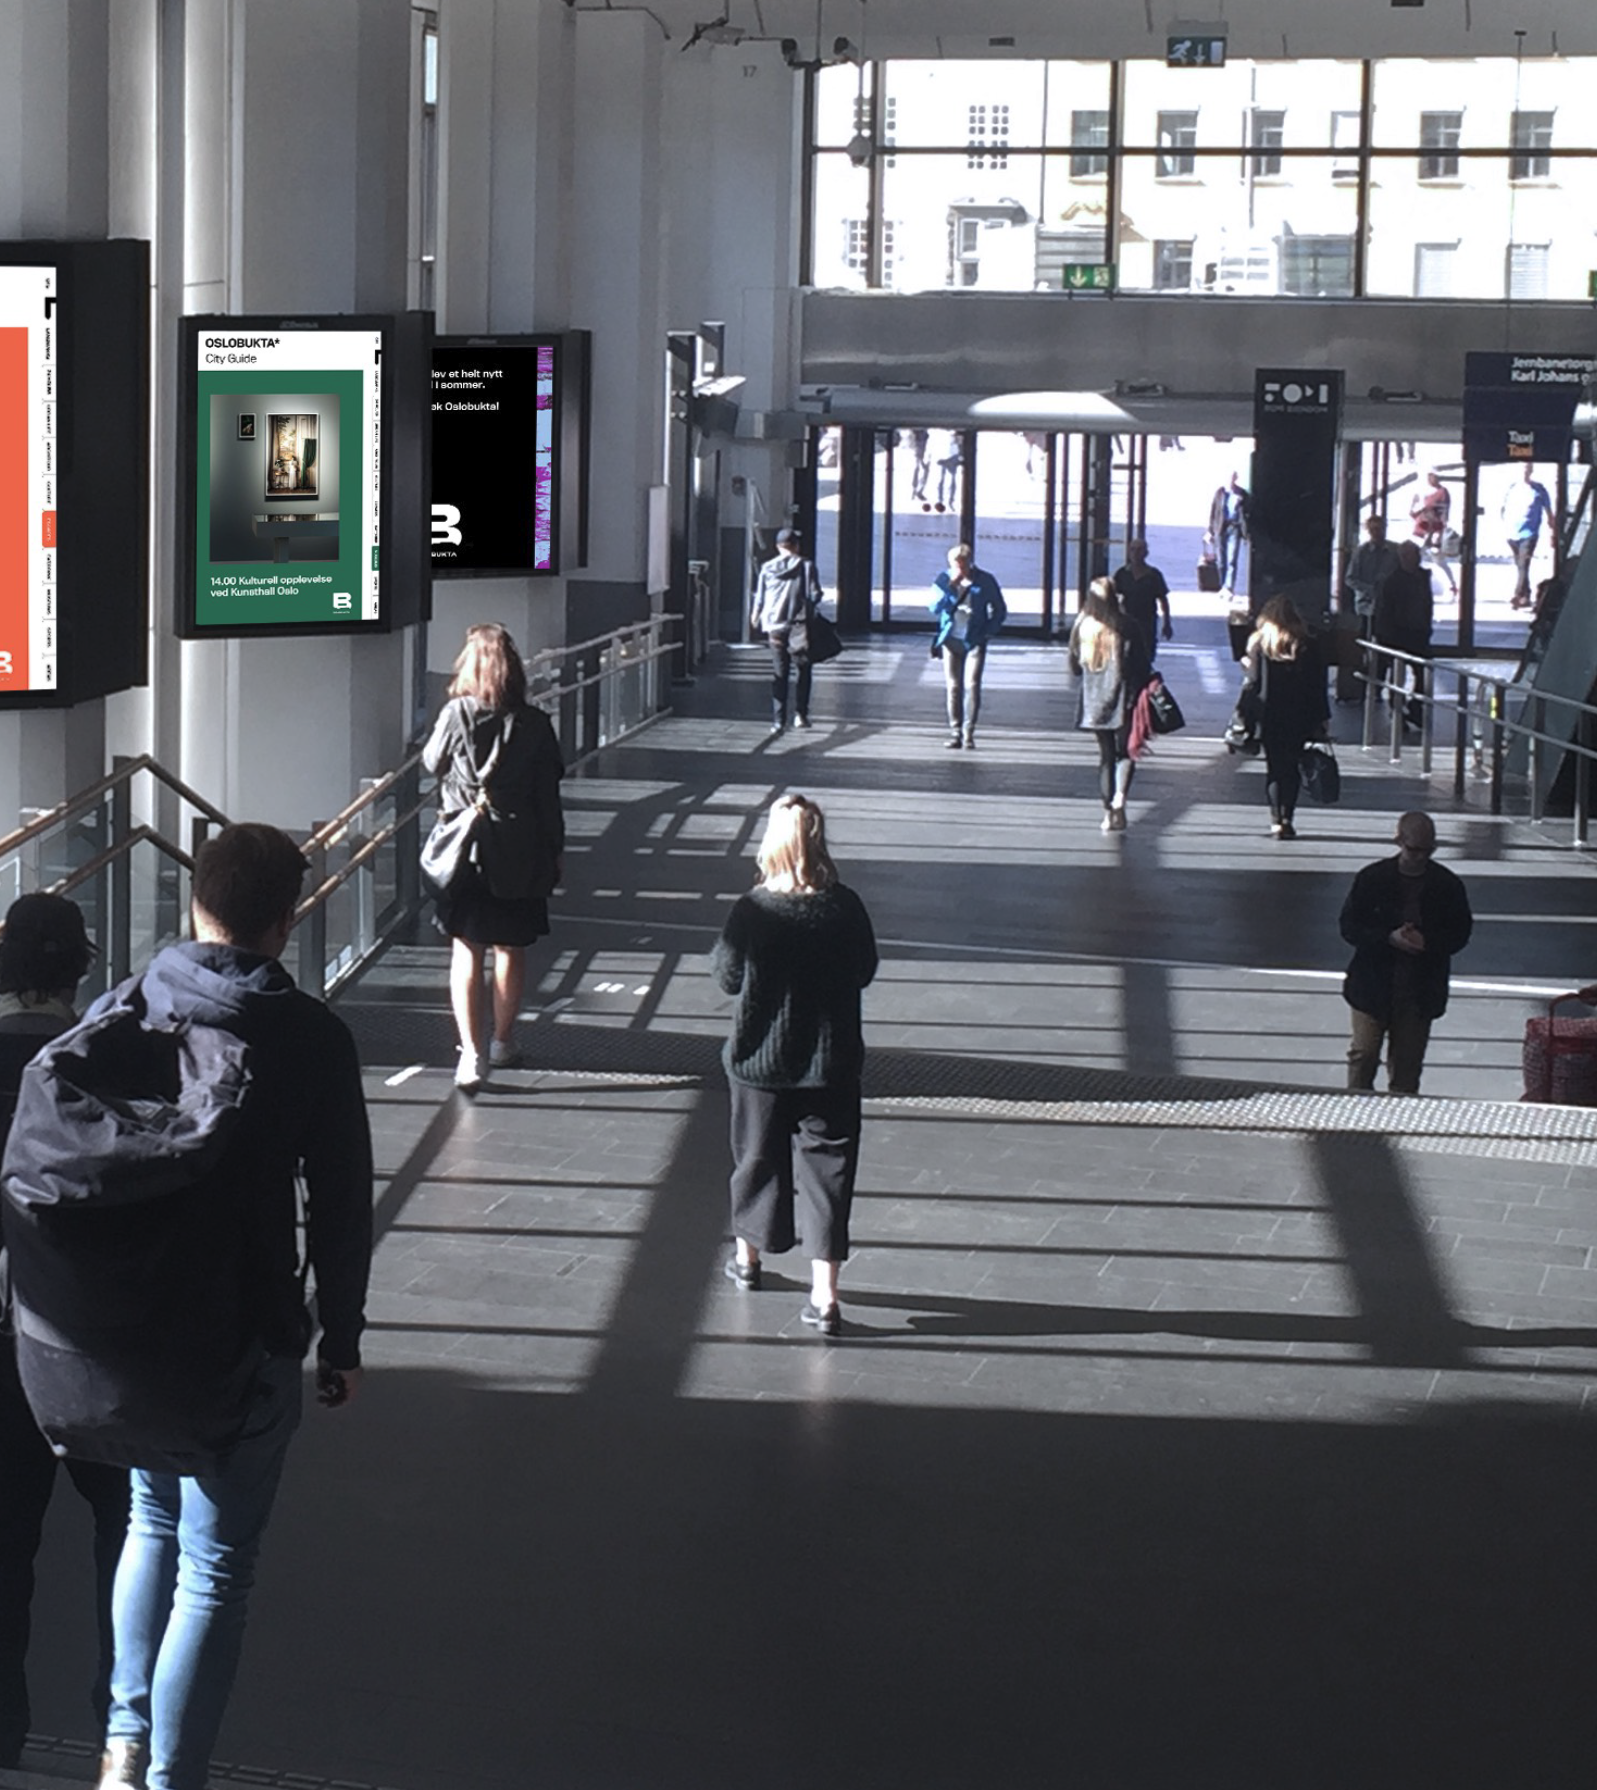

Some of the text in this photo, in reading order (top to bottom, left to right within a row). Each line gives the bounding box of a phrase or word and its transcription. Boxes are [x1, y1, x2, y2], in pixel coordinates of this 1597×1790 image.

[205, 353, 257, 365] City Guide
[449, 370, 460, 378] et
[461, 369, 481, 378] helt
[483, 369, 504, 380] nytt
[1511, 369, 1536, 382] Karl
[1537, 369, 1579, 383] Johans
[440, 381, 486, 389] sommer.
[1507, 430, 1534, 443] Taxi
[1507, 444, 1533, 457] Taxi
[210, 574, 333, 586] 14.00 Kulturell opplevelse
[210, 585, 300, 597] ved Kunsthall Oslo
